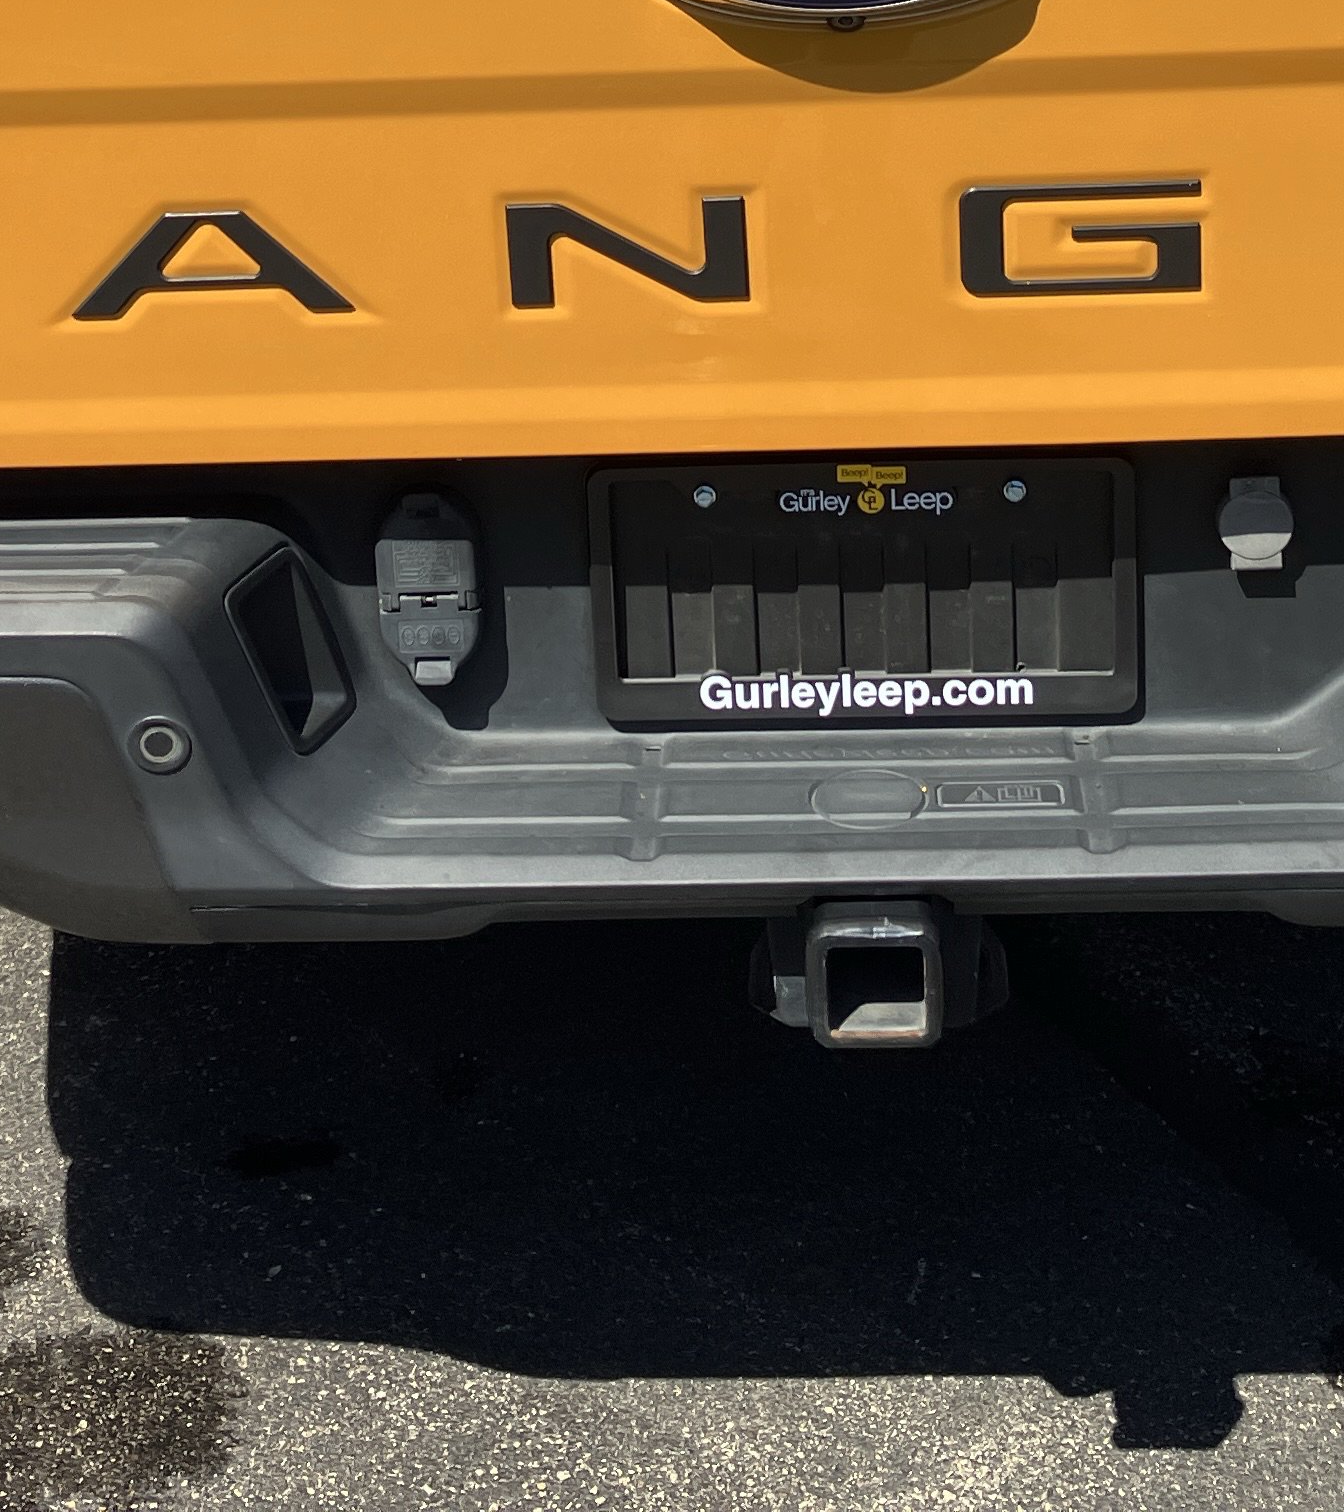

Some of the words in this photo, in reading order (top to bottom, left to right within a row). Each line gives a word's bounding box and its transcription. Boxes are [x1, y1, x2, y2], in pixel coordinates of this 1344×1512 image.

[840, 468, 869, 478] Beep!
[875, 471, 904, 481] Beep!
[779, 490, 851, 516] Gurley
[890, 488, 954, 516] Leep
[699, 673, 1034, 717] Gurleyleep.com
